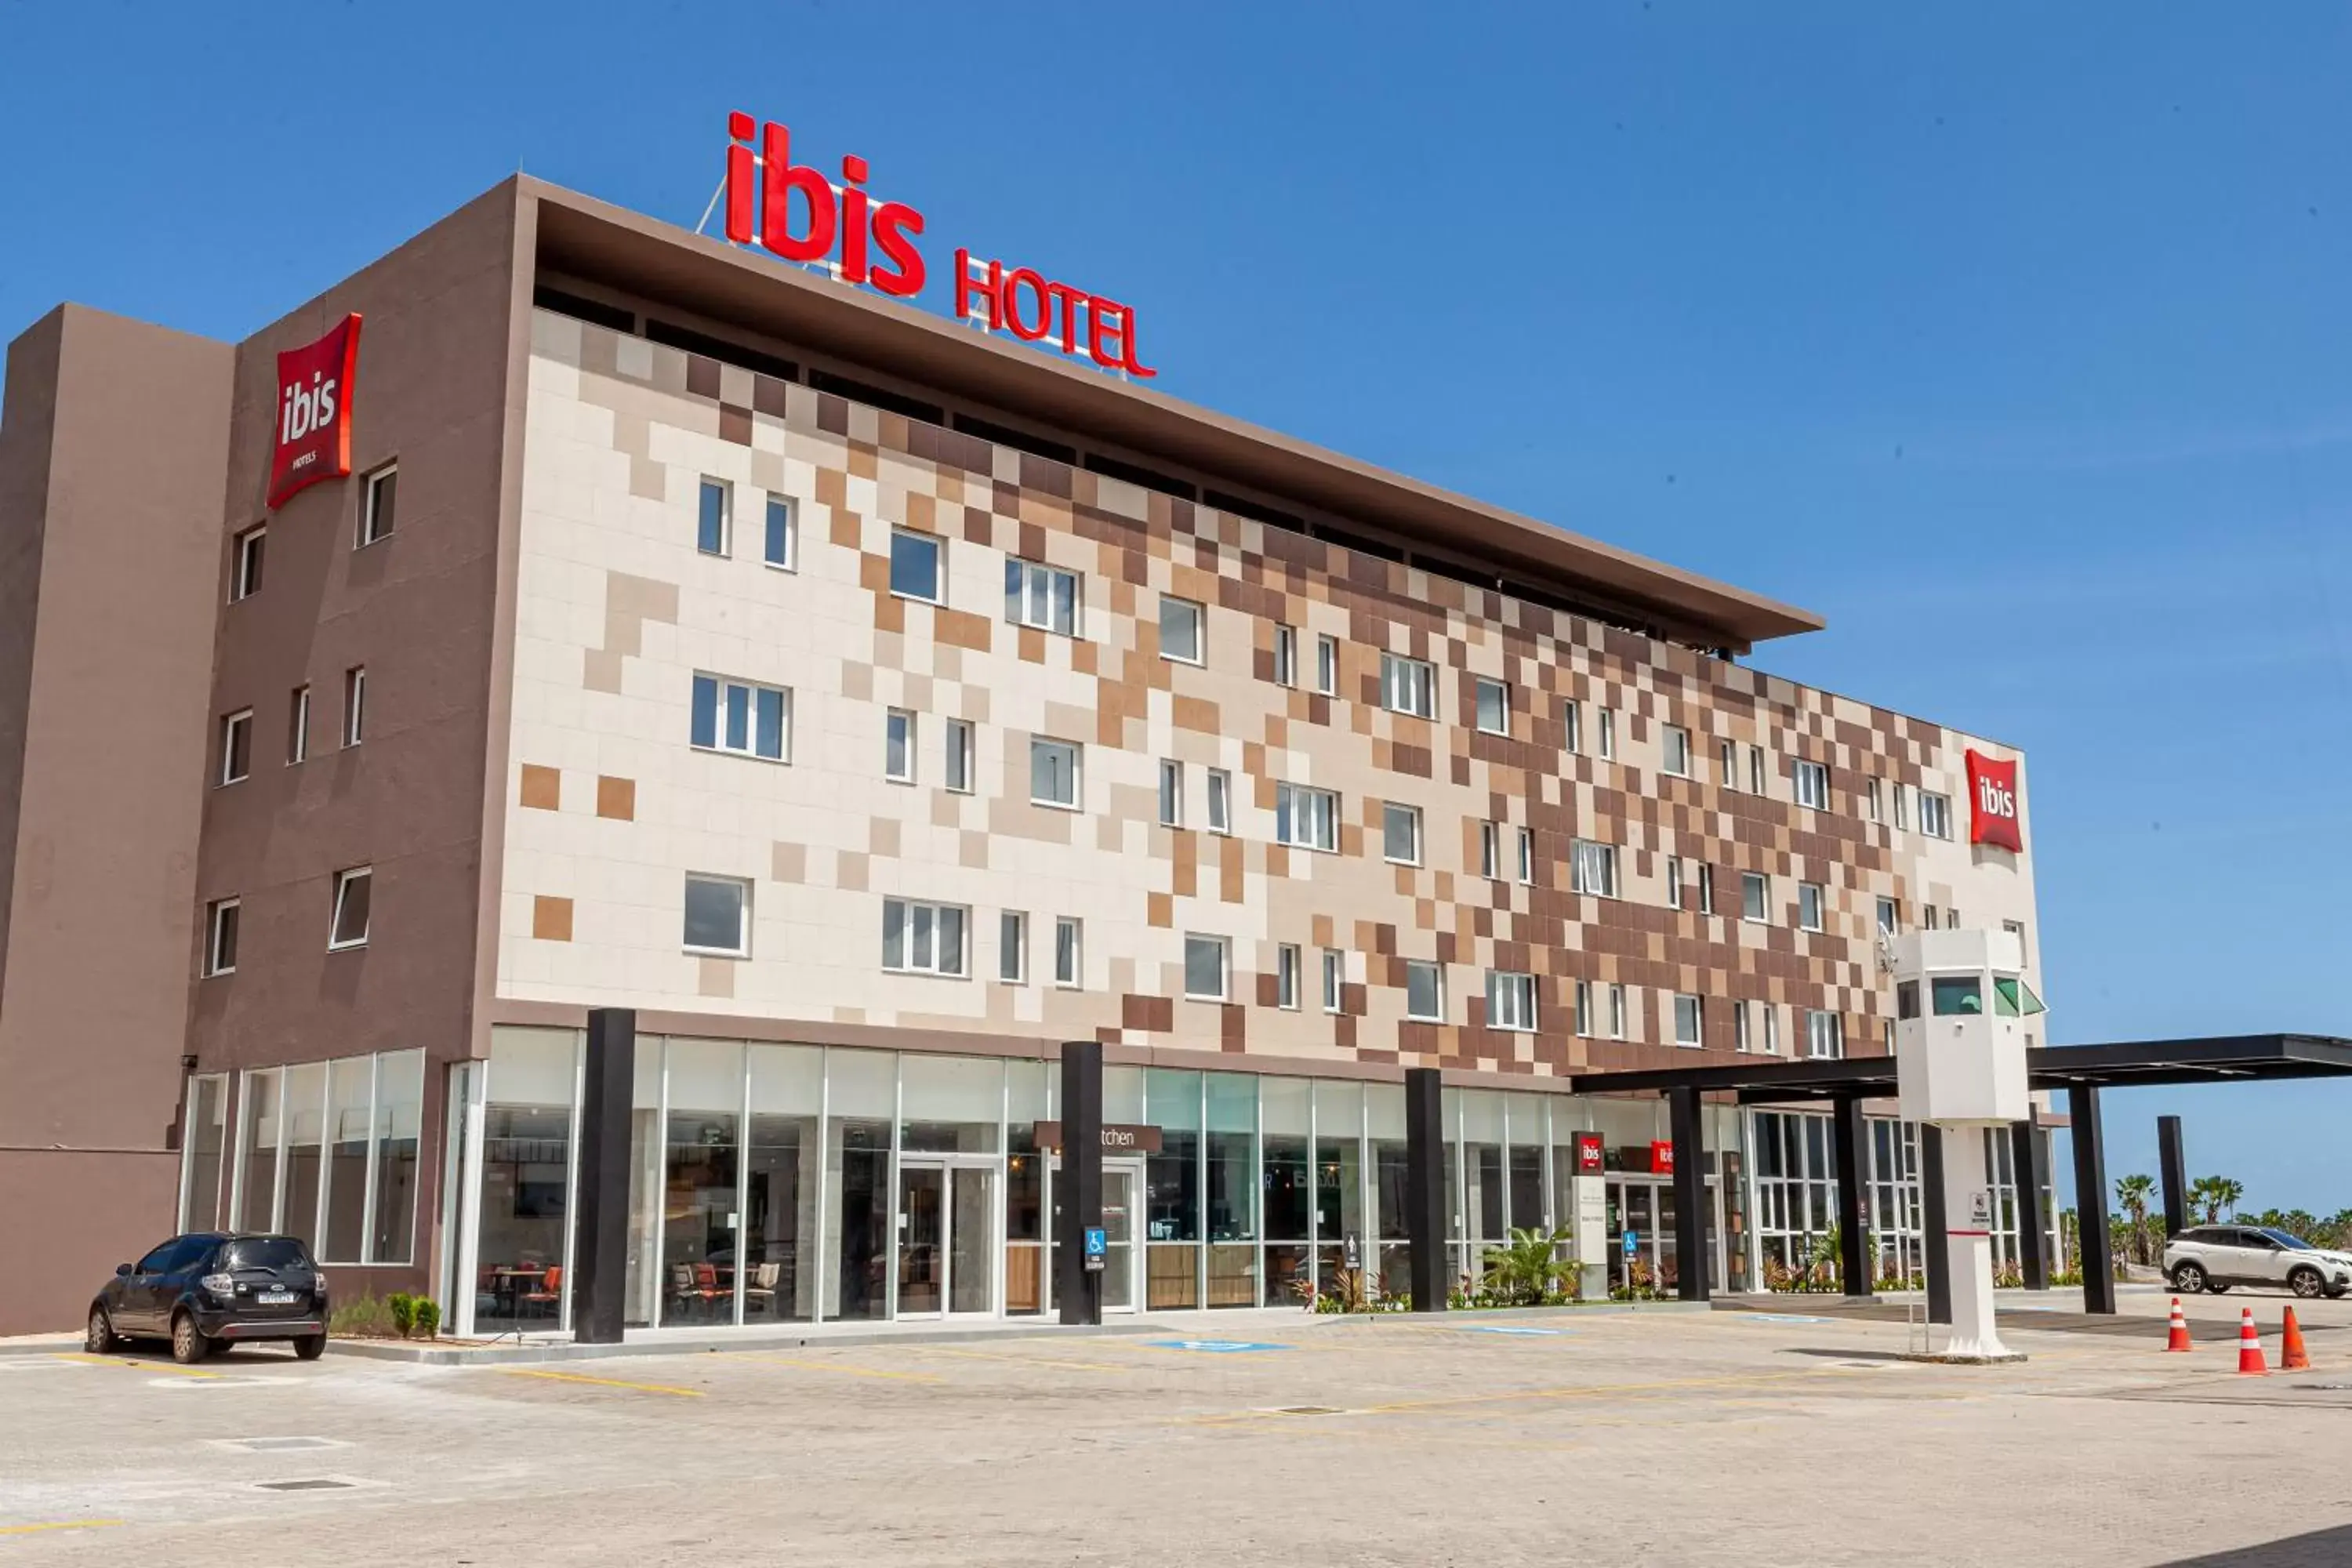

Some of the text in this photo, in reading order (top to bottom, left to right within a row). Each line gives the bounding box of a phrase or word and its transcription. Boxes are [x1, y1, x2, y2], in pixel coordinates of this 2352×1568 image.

[726, 110, 1156, 377] ibis HOTEL
[281, 371, 336, 445] ibis
[292, 450, 316, 470] HOTELS
[1979, 775, 2014, 818] ibis
[1102, 1128, 1134, 1145] tchen
[1583, 1144, 1599, 1160] ibis
